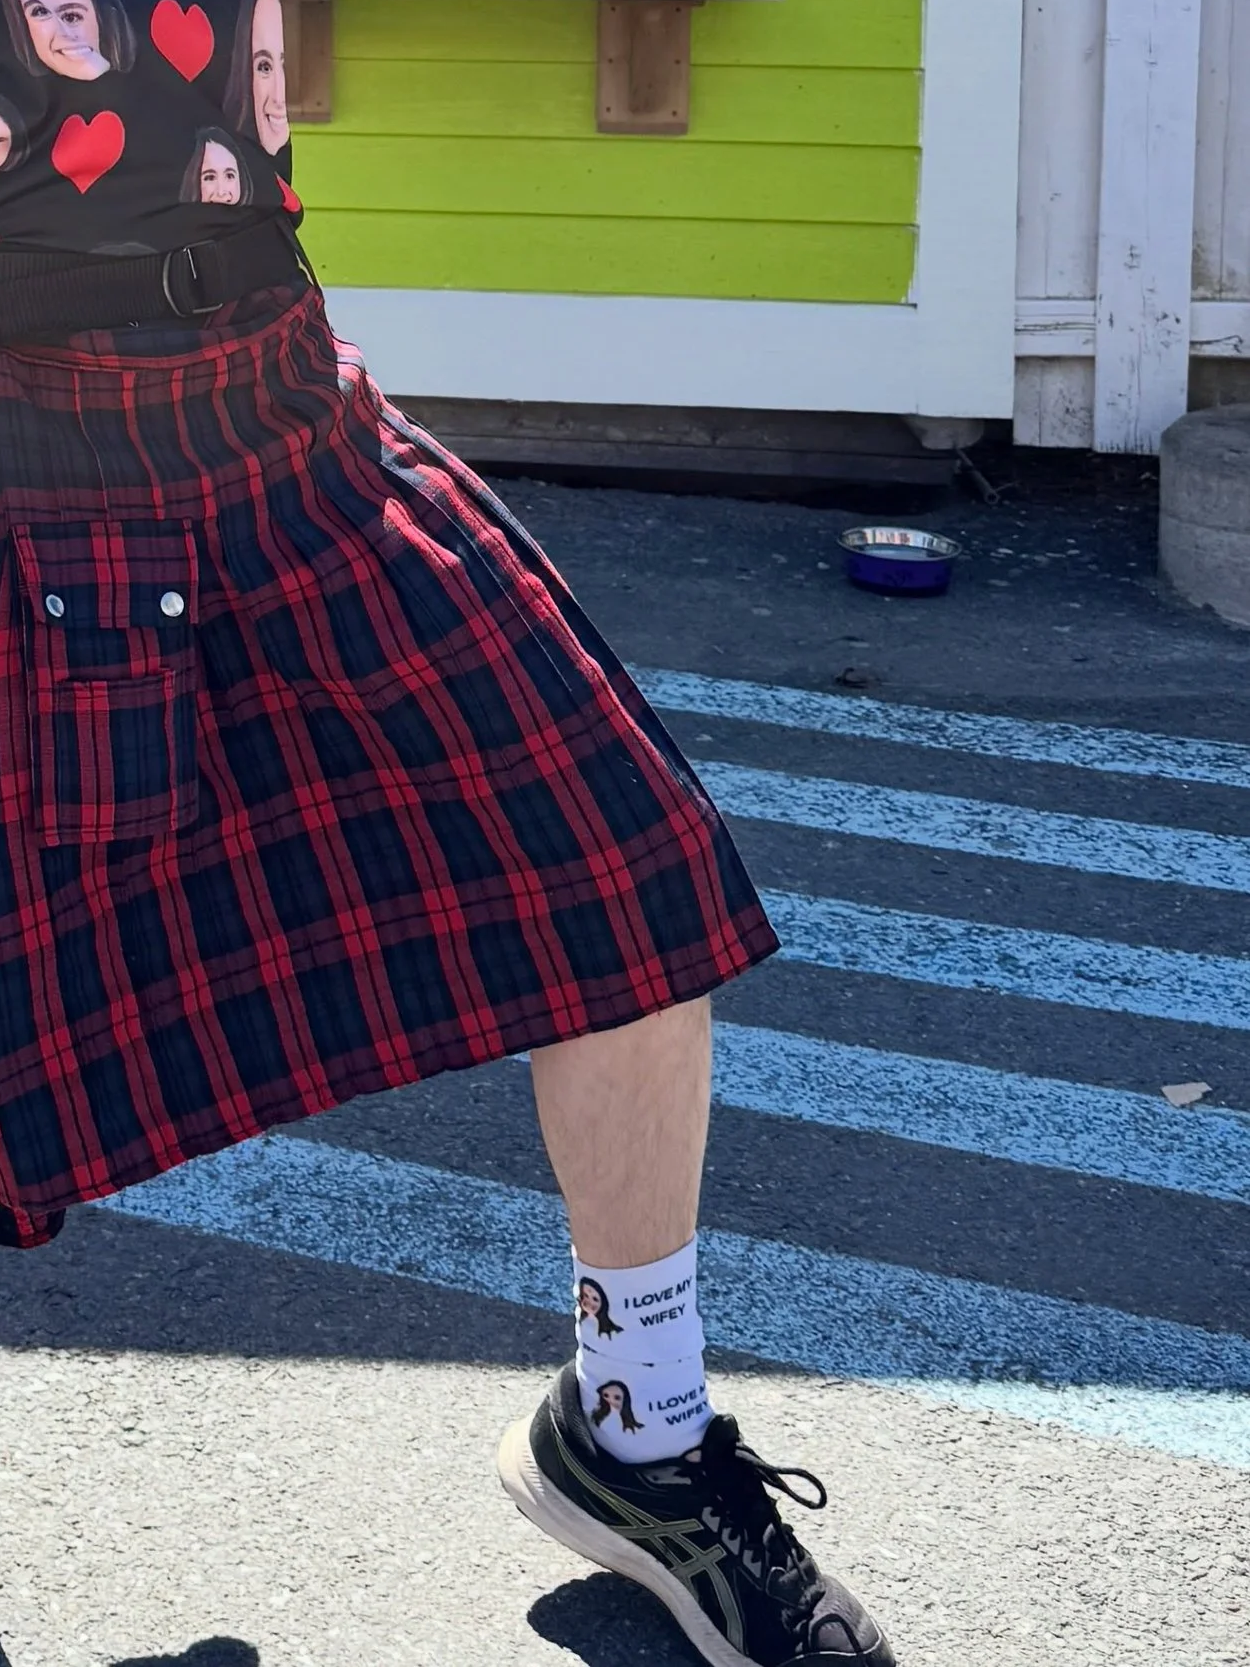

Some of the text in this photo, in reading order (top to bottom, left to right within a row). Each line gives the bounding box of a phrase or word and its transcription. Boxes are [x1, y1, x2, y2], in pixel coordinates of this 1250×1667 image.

[624, 1275, 693, 1309] I LOVE MY
[639, 1303, 686, 1327] WIFEY
[648, 1401, 653, 1412] I
[657, 1389, 697, 1410] LOVE
